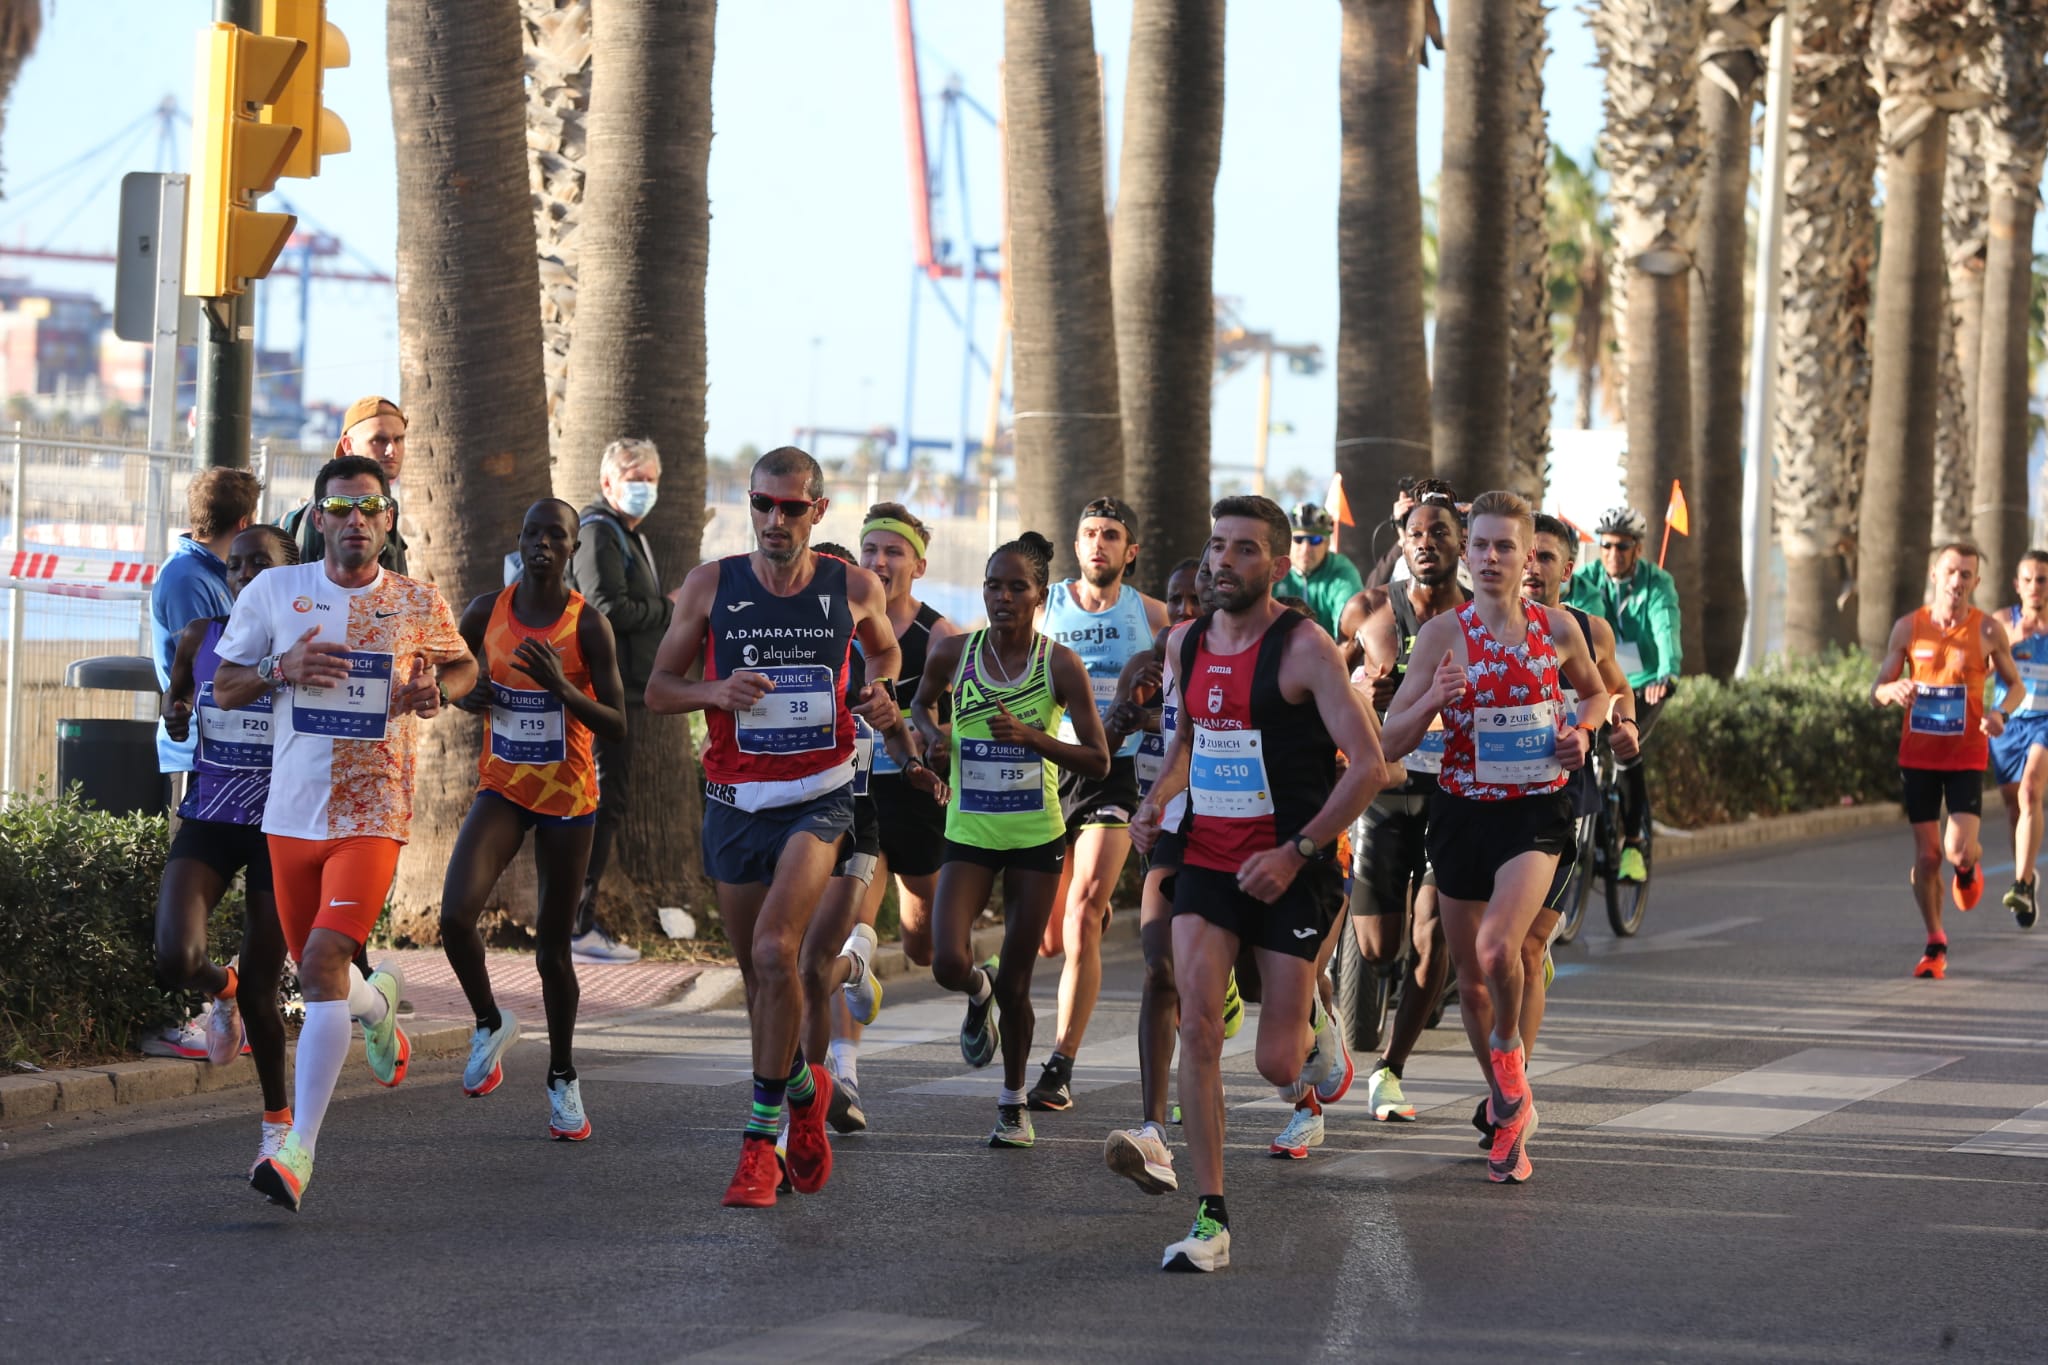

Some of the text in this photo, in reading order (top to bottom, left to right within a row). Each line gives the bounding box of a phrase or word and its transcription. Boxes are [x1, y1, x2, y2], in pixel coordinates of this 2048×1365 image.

[315, 603, 331, 612] NN
[725, 628, 835, 640] A.D.MARATHON
[1054, 623, 1120, 643] nerja
[763, 644, 817, 665] alquiber
[344, 658, 373, 669] RICH
[773, 674, 813, 684] ZURICH
[346, 685, 366, 698] 14
[511, 696, 545, 705] ZURICH
[789, 701, 809, 714] 38
[242, 719, 269, 731] F20
[520, 719, 545, 730] F19
[1206, 739, 1240, 749] ZURICH
[1515, 733, 1548, 748] 4517
[990, 746, 1025, 756] ZURICH
[1000, 769, 1024, 780] F35
[1214, 764, 1249, 778] 4510
